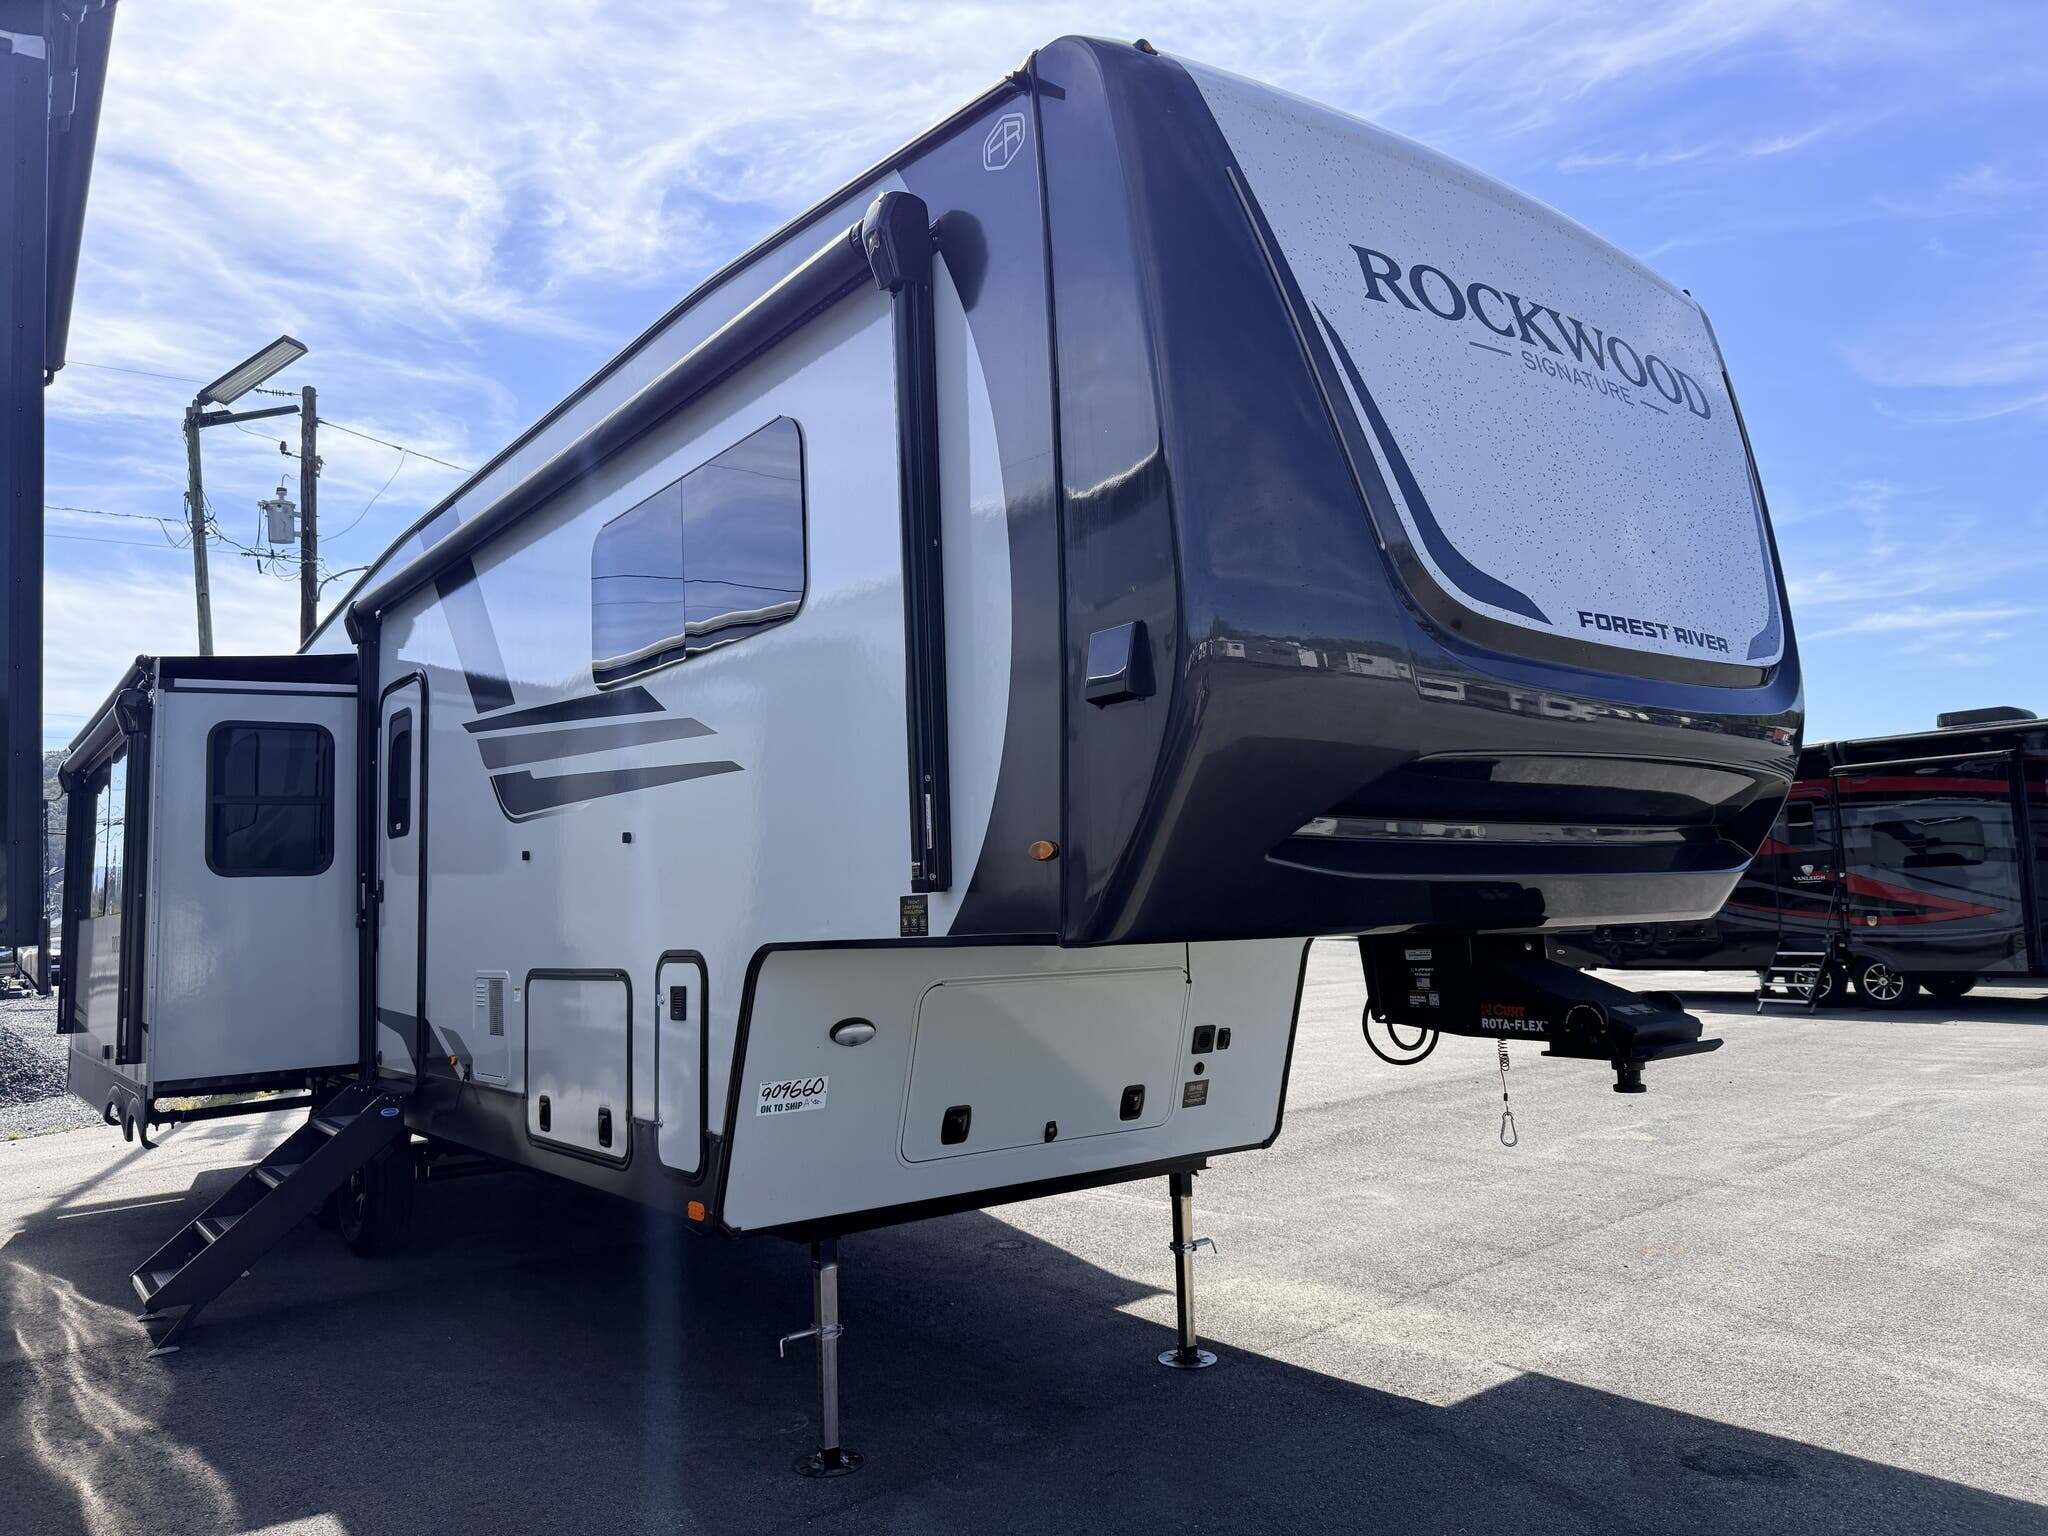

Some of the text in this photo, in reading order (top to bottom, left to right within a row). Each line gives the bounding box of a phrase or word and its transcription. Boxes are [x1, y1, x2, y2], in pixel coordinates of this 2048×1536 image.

[1349, 243, 1712, 420] ROCKWOOD
[1521, 350, 1635, 406] SIGNATURE
[1577, 611, 1729, 653] FOREST RIVER
[1493, 1003, 1526, 1017] CURT
[761, 1105, 772, 1114] OK
[774, 1104, 783, 1112] TO
[785, 1101, 803, 1111] SHIP
